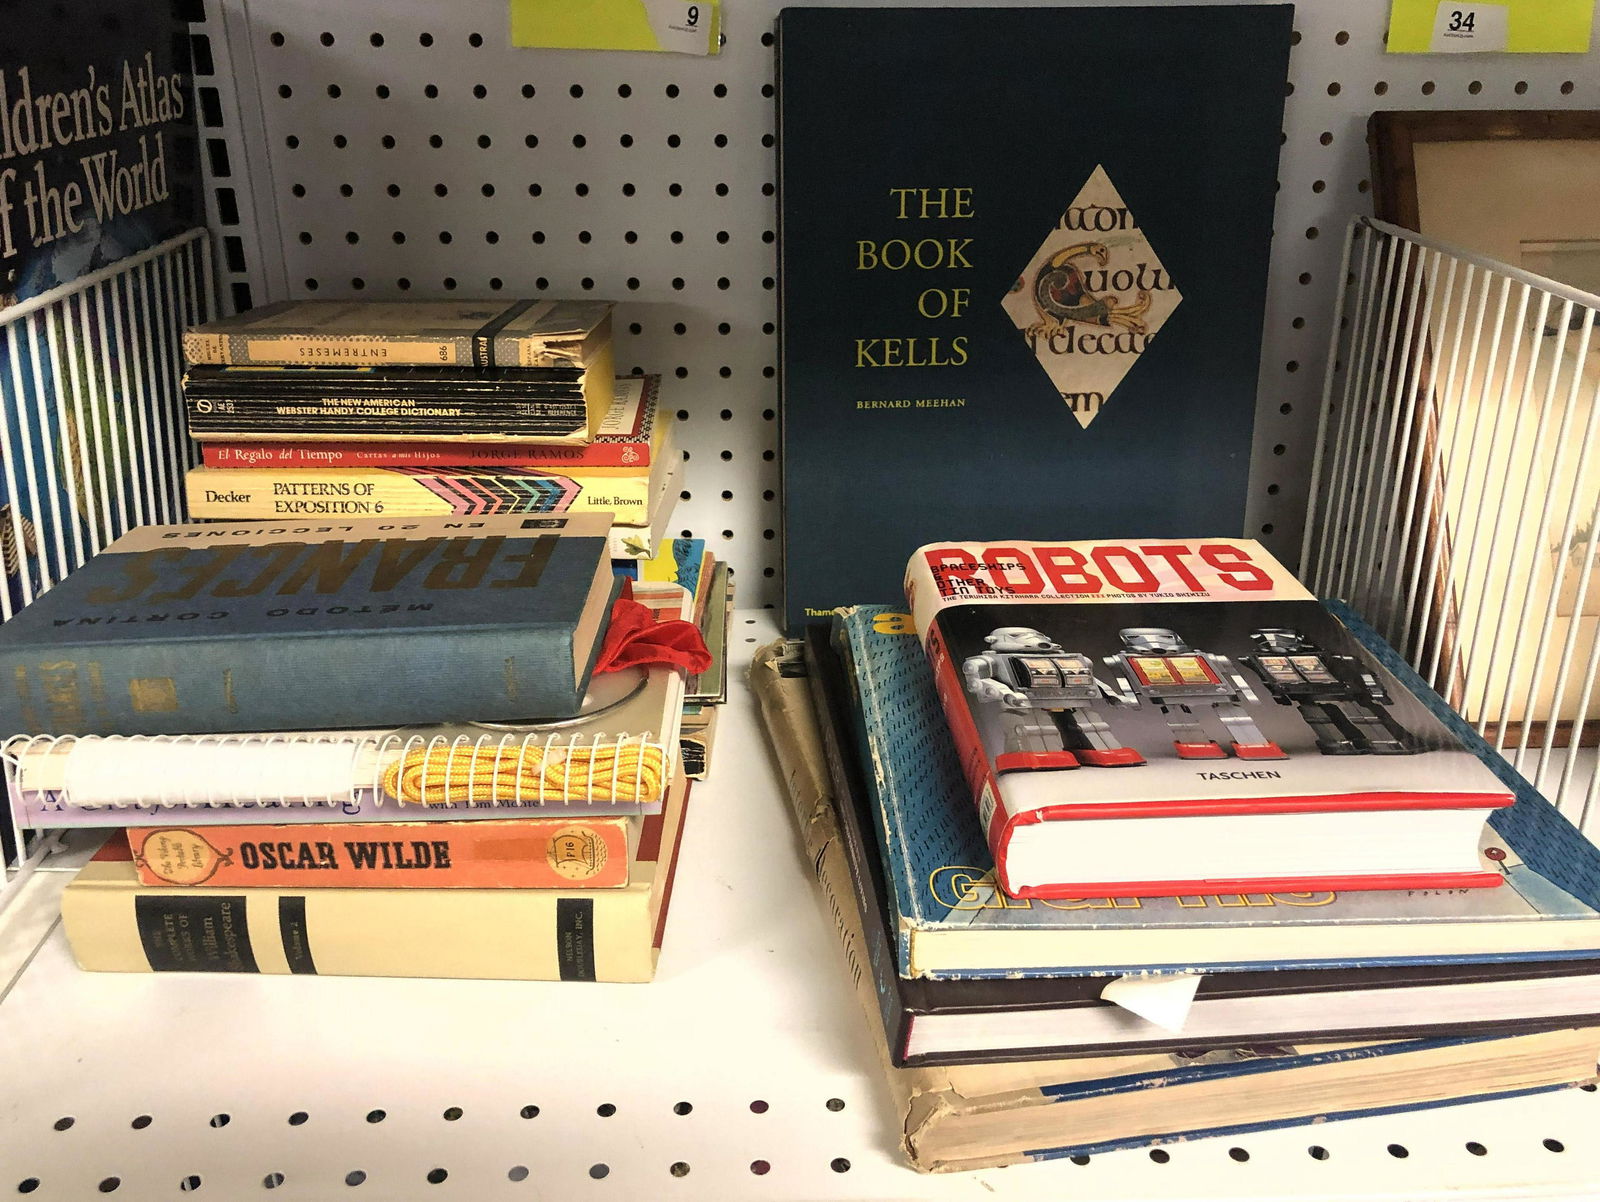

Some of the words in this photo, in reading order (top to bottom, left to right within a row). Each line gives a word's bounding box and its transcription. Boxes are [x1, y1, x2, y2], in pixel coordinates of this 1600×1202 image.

[687, 5, 699, 26] 9
[1449, 10, 1475, 31] 34
[119, 51, 184, 131] Atlas
[24, 160, 84, 248] the
[80, 131, 169, 225] World
[889, 187, 976, 220] THE
[856, 238, 975, 270] BOOK
[917, 288, 971, 319] OF
[300, 347, 388, 358] ENTREMESES
[855, 336, 969, 368] KELLS
[322, 398, 340, 407] THE
[341, 398, 361, 408] NEW
[364, 398, 416, 408] AMERICAN
[856, 400, 912, 410] BERNARD
[916, 398, 966, 409] MEEHAN
[276, 406, 318, 415] WEBSTER
[320, 407, 354, 415] HANDY
[356, 407, 398, 416] COLLEGE
[400, 407, 461, 418] DICTIONARY
[218, 449, 230, 460] El
[235, 448, 273, 463] Regalo
[279, 448, 292, 460] del
[299, 448, 344, 464] Tiempo
[356, 451, 387, 459] Cartas
[414, 450, 441, 461] Hijos
[470, 449, 521, 460] JORGE
[528, 449, 585, 460] RAMOS
[206, 490, 251, 503] Decker
[273, 483, 350, 496] PATTERNS
[353, 483, 375, 495] OF
[275, 500, 370, 514] EXPOSITION
[374, 502, 384, 513] 6
[587, 496, 612, 507] Little,
[613, 496, 643, 506] Brown
[162, 525, 354, 540] LECCIONES
[924, 545, 1274, 597] ROBOTS
[930, 562, 1026, 574] SPACESHIPS
[936, 578, 985, 590] OTHER
[941, 587, 969, 597] TIN
[975, 586, 1016, 595] TOYS
[53, 610, 230, 627] CORTINA
[1196, 769, 1281, 782] TASCHEN
[240, 841, 338, 869] OSCAR
[344, 840, 452, 869] WILDE
[203, 915, 220, 960] William
